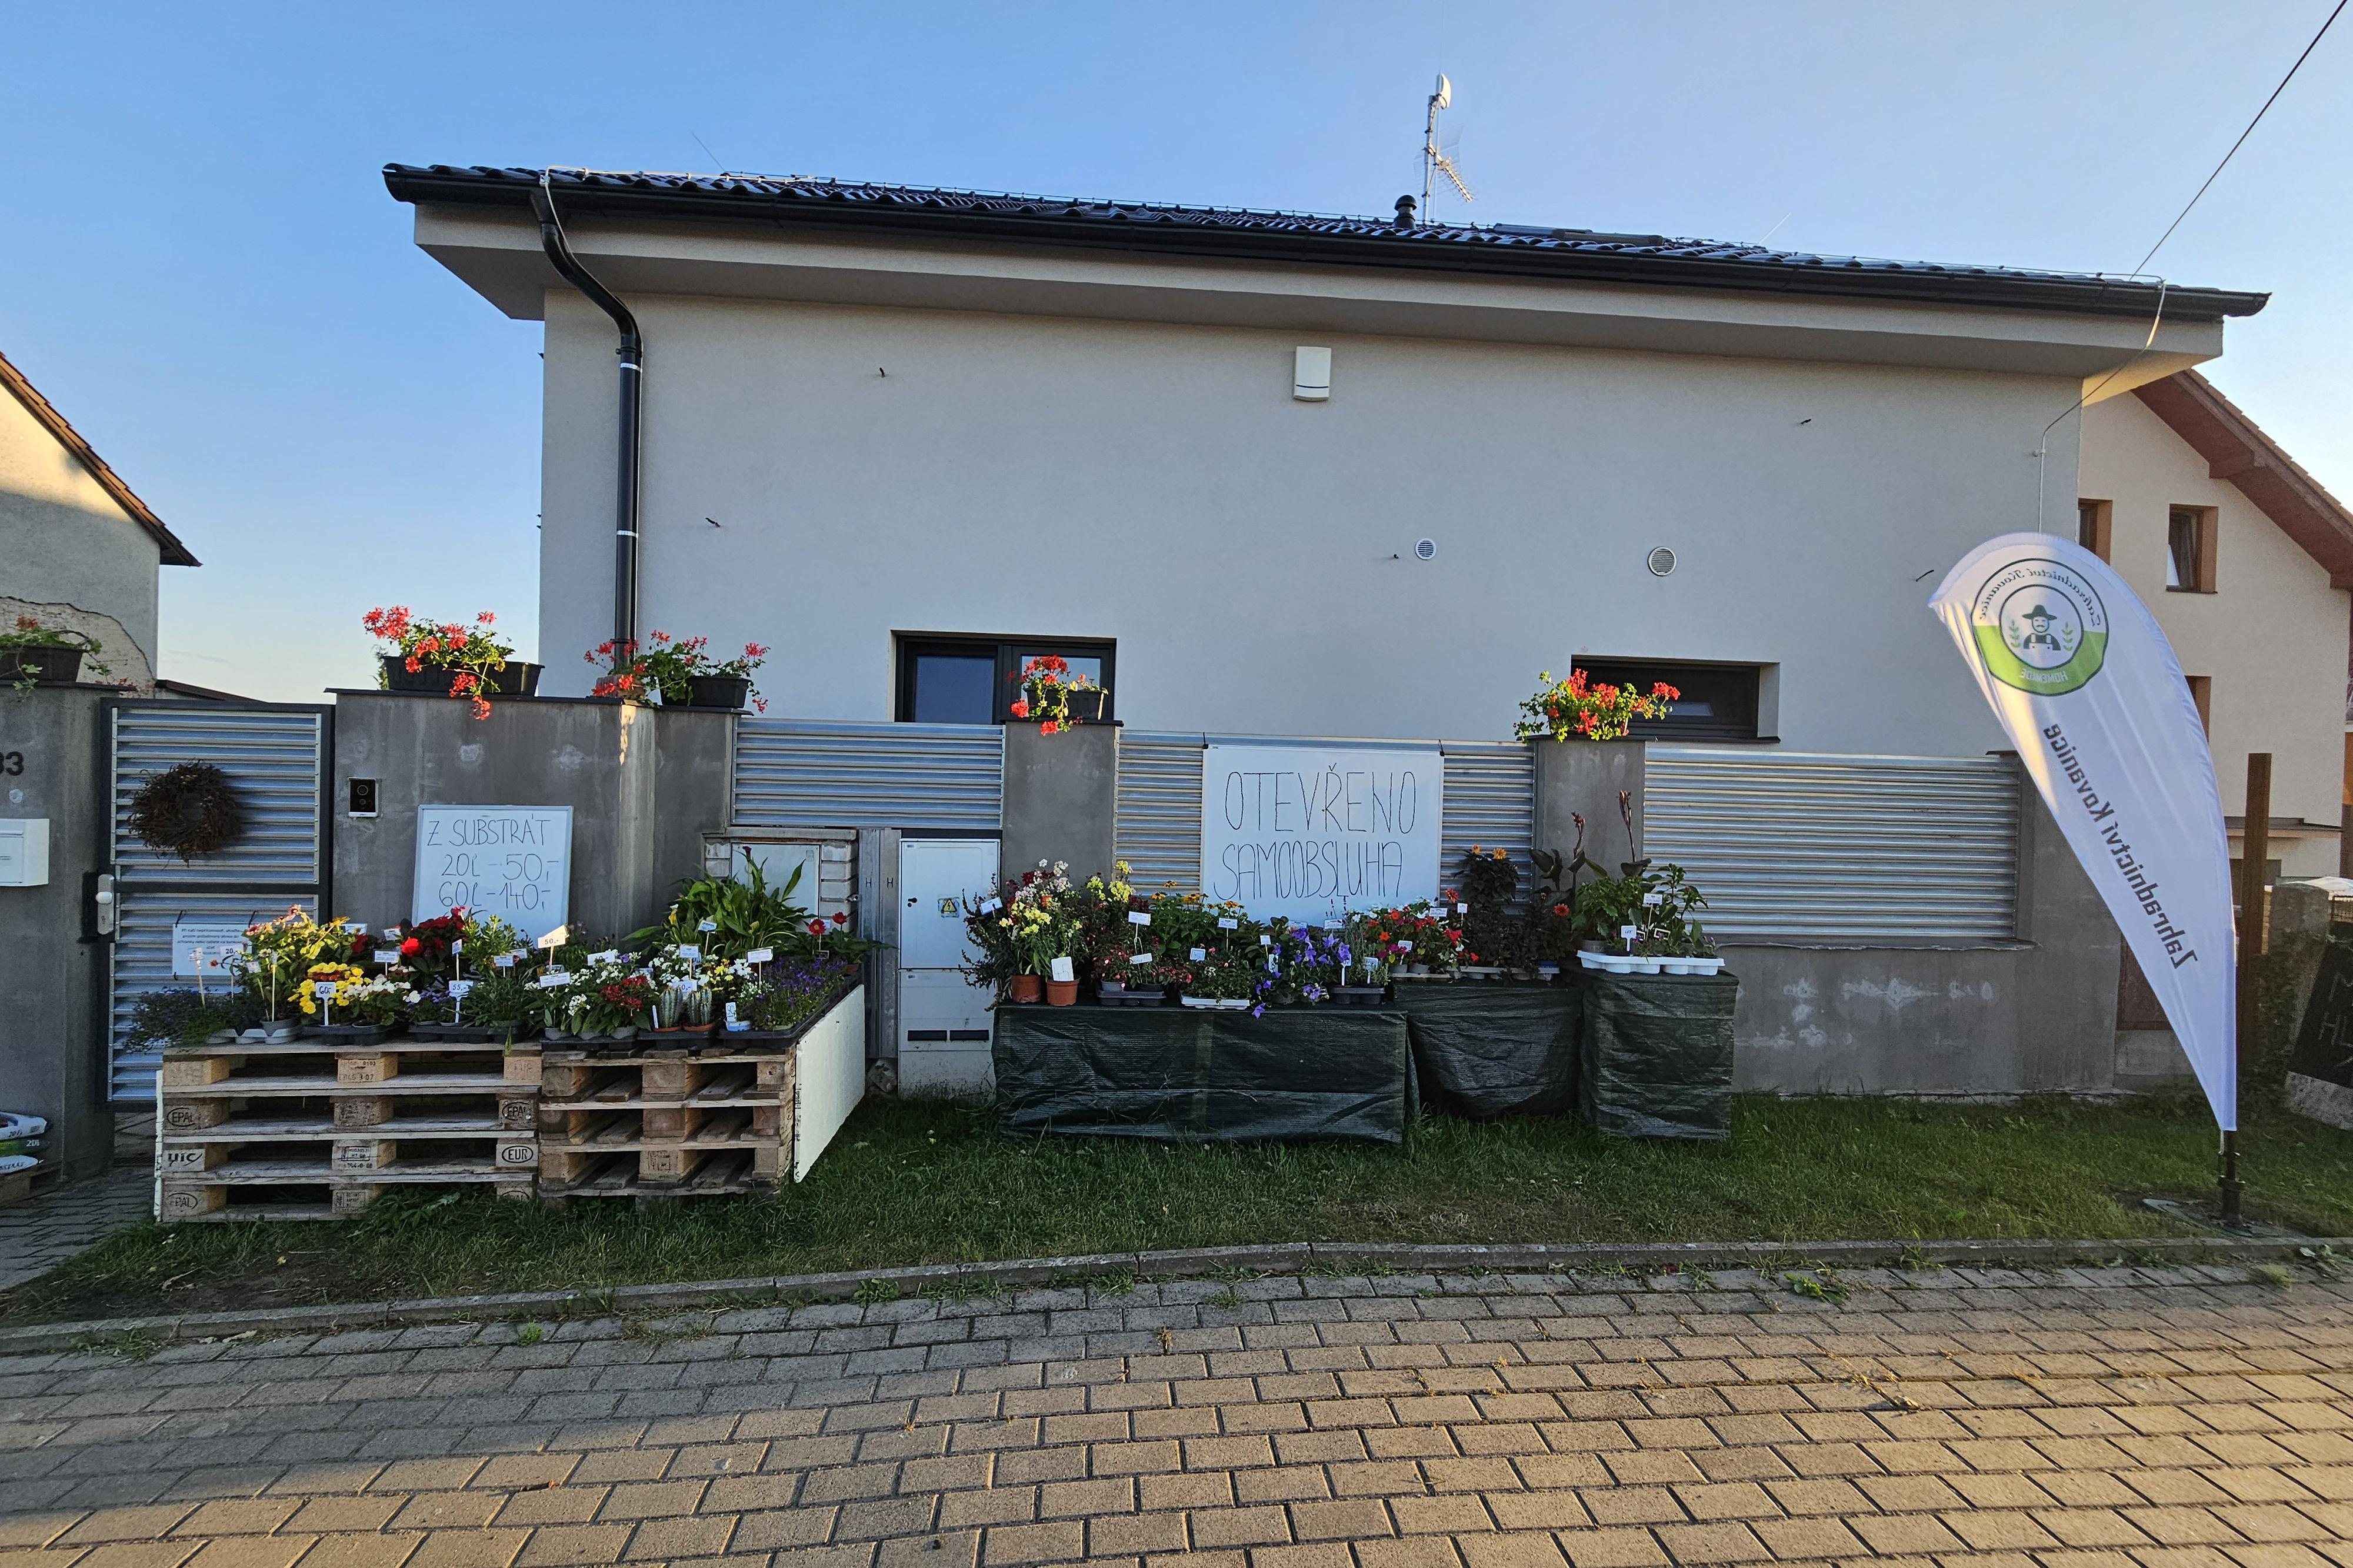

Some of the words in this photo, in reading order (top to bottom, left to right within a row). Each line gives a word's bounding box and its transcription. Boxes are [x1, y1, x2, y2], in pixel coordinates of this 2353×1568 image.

[0, 751, 24, 776] 3
[1225, 762, 1417, 834] OTEVŘENO
[1213, 840, 1402, 900] SAMOOBSLUHA
[508, 1148, 528, 1160] EUR
